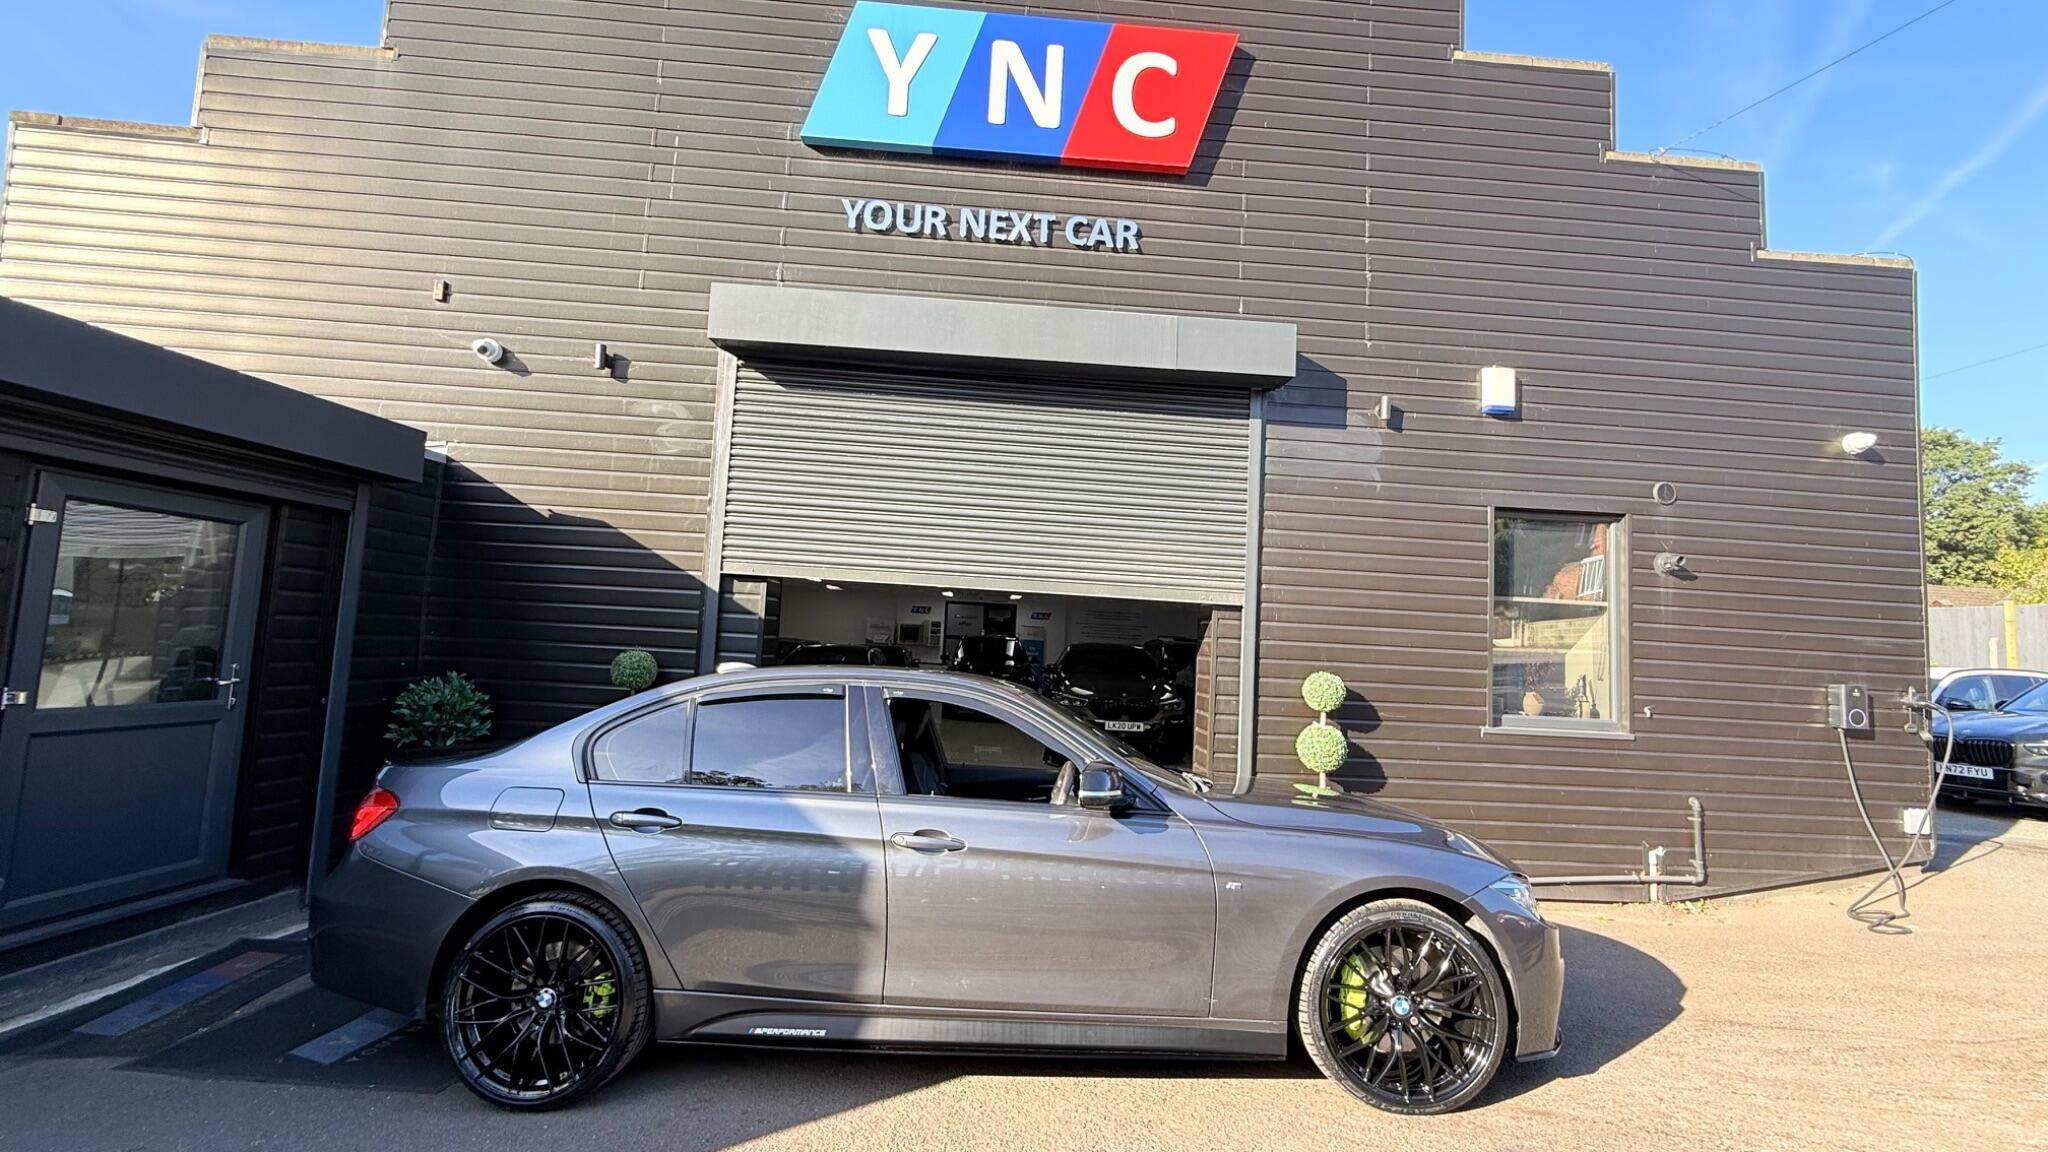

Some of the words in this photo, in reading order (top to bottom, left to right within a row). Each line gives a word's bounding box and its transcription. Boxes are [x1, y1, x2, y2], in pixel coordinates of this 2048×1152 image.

[867, 27, 1178, 138] YNC
[841, 198, 947, 238] YOUR
[960, 207, 1056, 245] NEXT
[1065, 215, 1140, 250] CAR
[1967, 766, 1988, 777] FYU
[761, 1027, 827, 1037] PERFORMANCE
